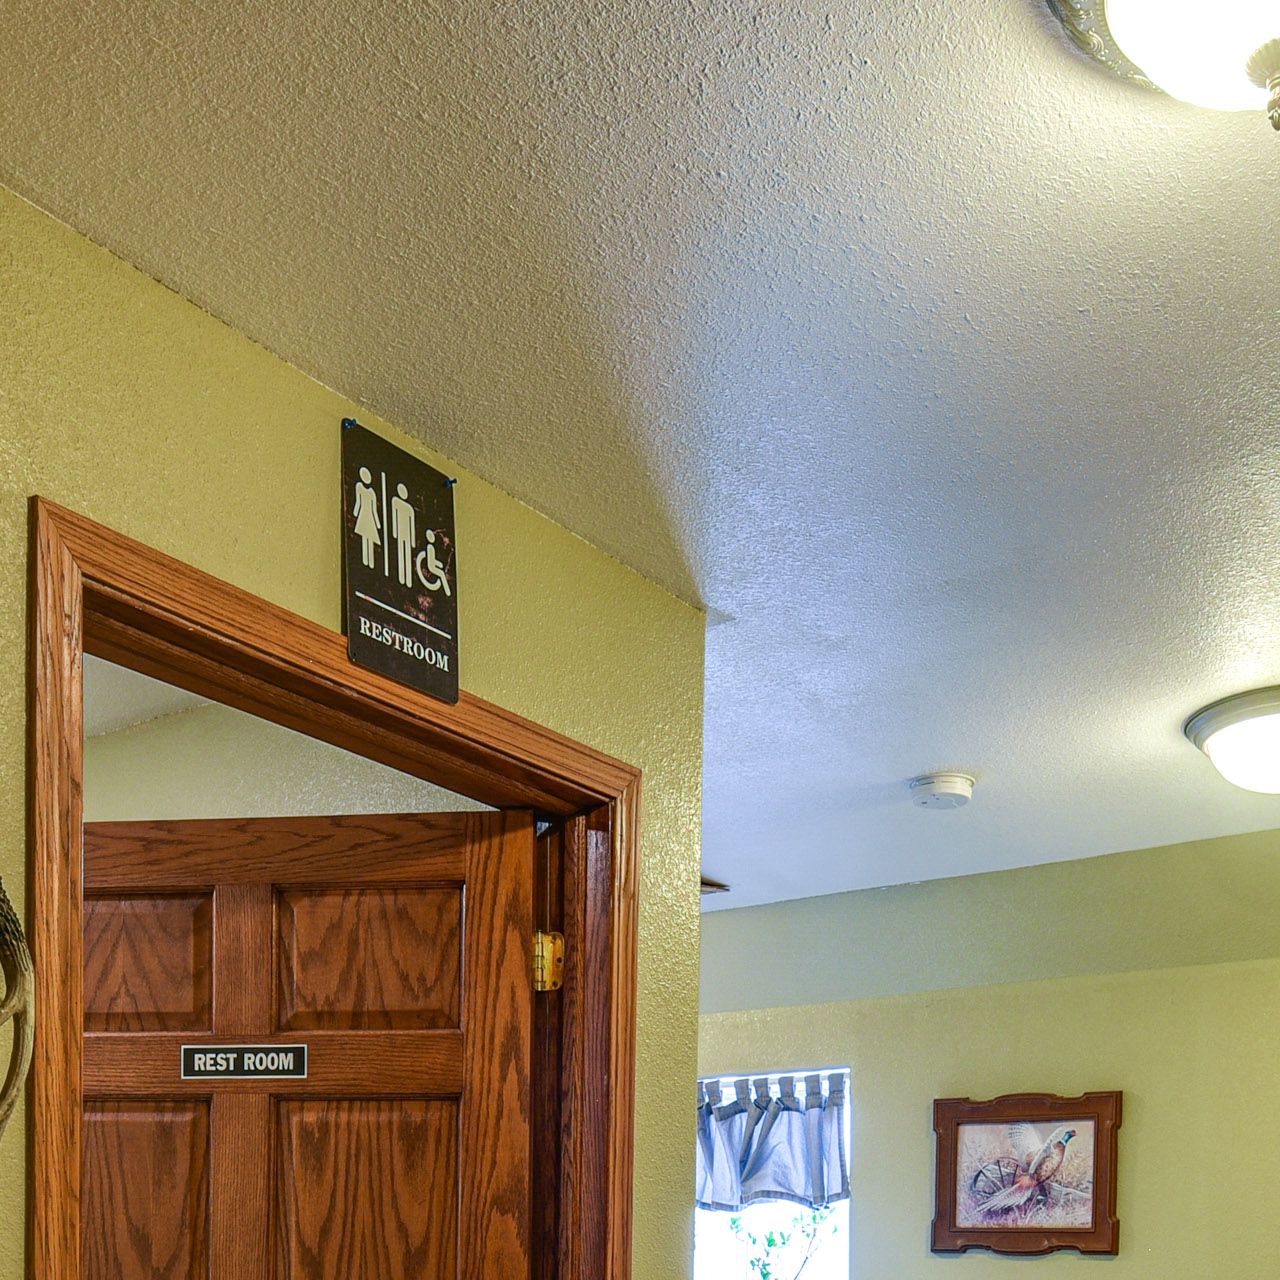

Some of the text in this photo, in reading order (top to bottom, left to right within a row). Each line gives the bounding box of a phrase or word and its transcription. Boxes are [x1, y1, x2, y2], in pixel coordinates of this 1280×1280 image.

[359, 616, 450, 673] RESTROOM
[194, 1052, 294, 1071] REST ROOM
